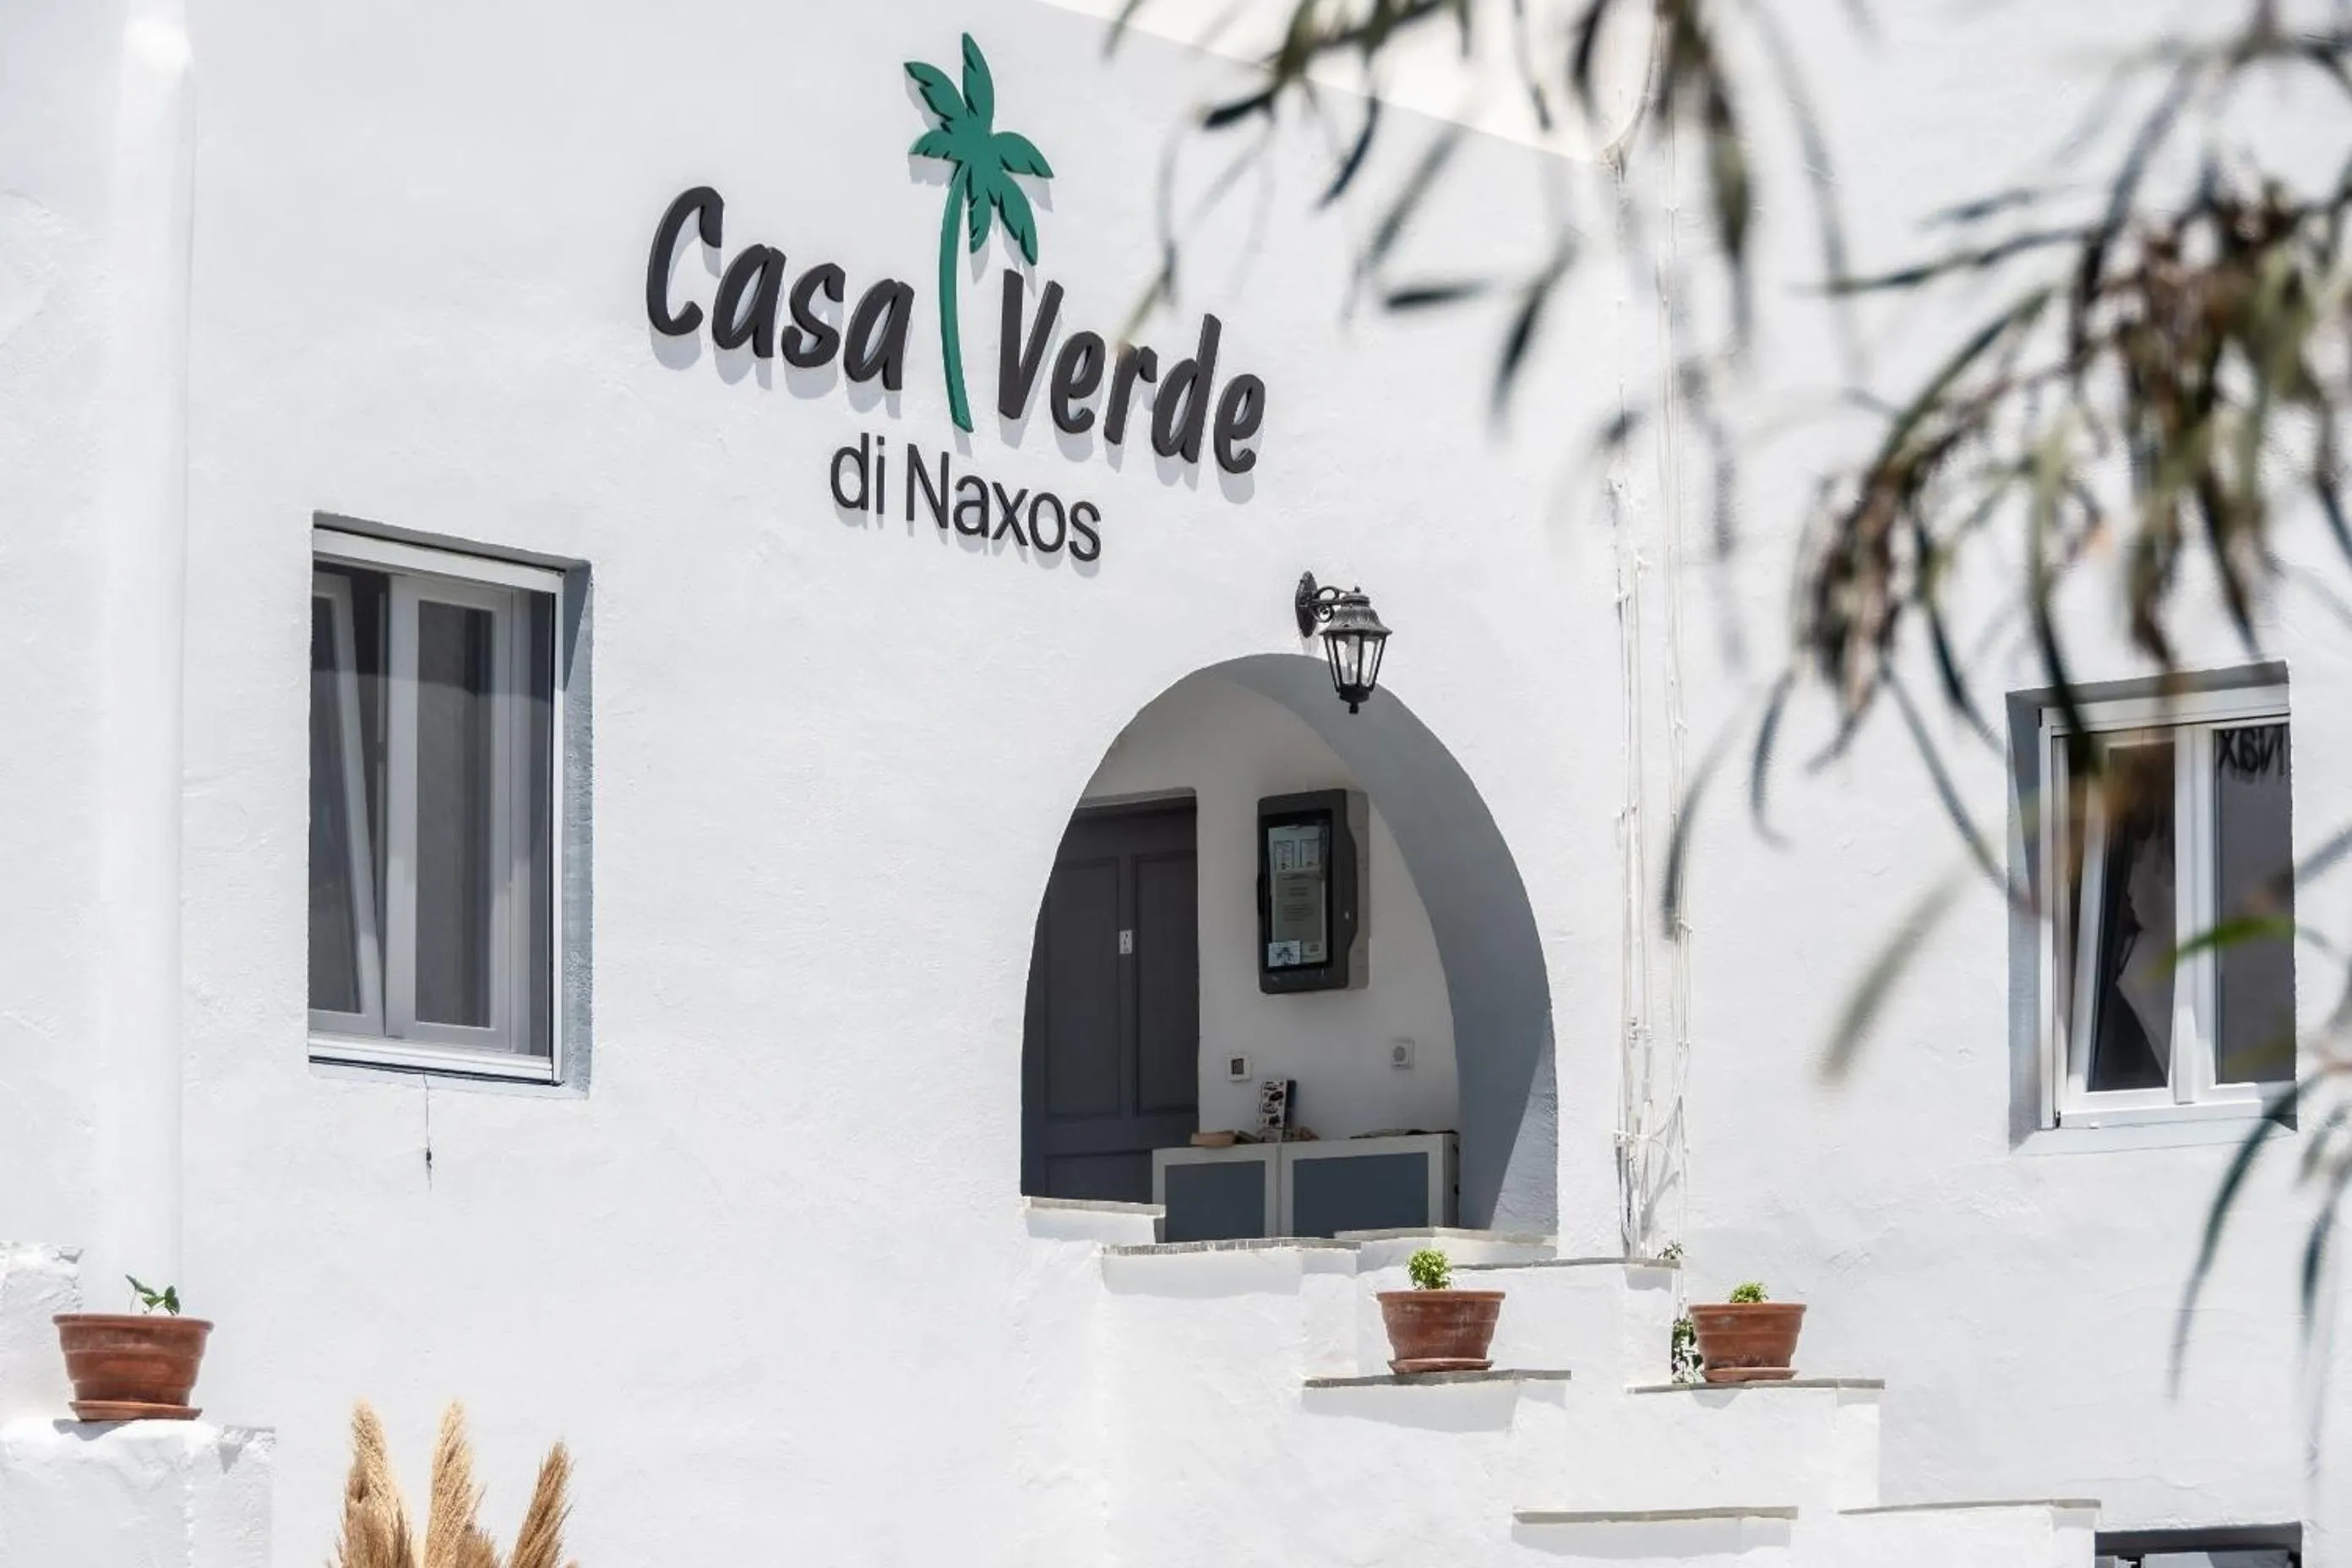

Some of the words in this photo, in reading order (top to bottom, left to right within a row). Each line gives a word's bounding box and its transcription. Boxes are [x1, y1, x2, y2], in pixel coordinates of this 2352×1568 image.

[646, 186, 915, 392] Casa
[999, 268, 1266, 475] Verde
[830, 432, 885, 515] di
[906, 443, 1102, 563] Naxos
